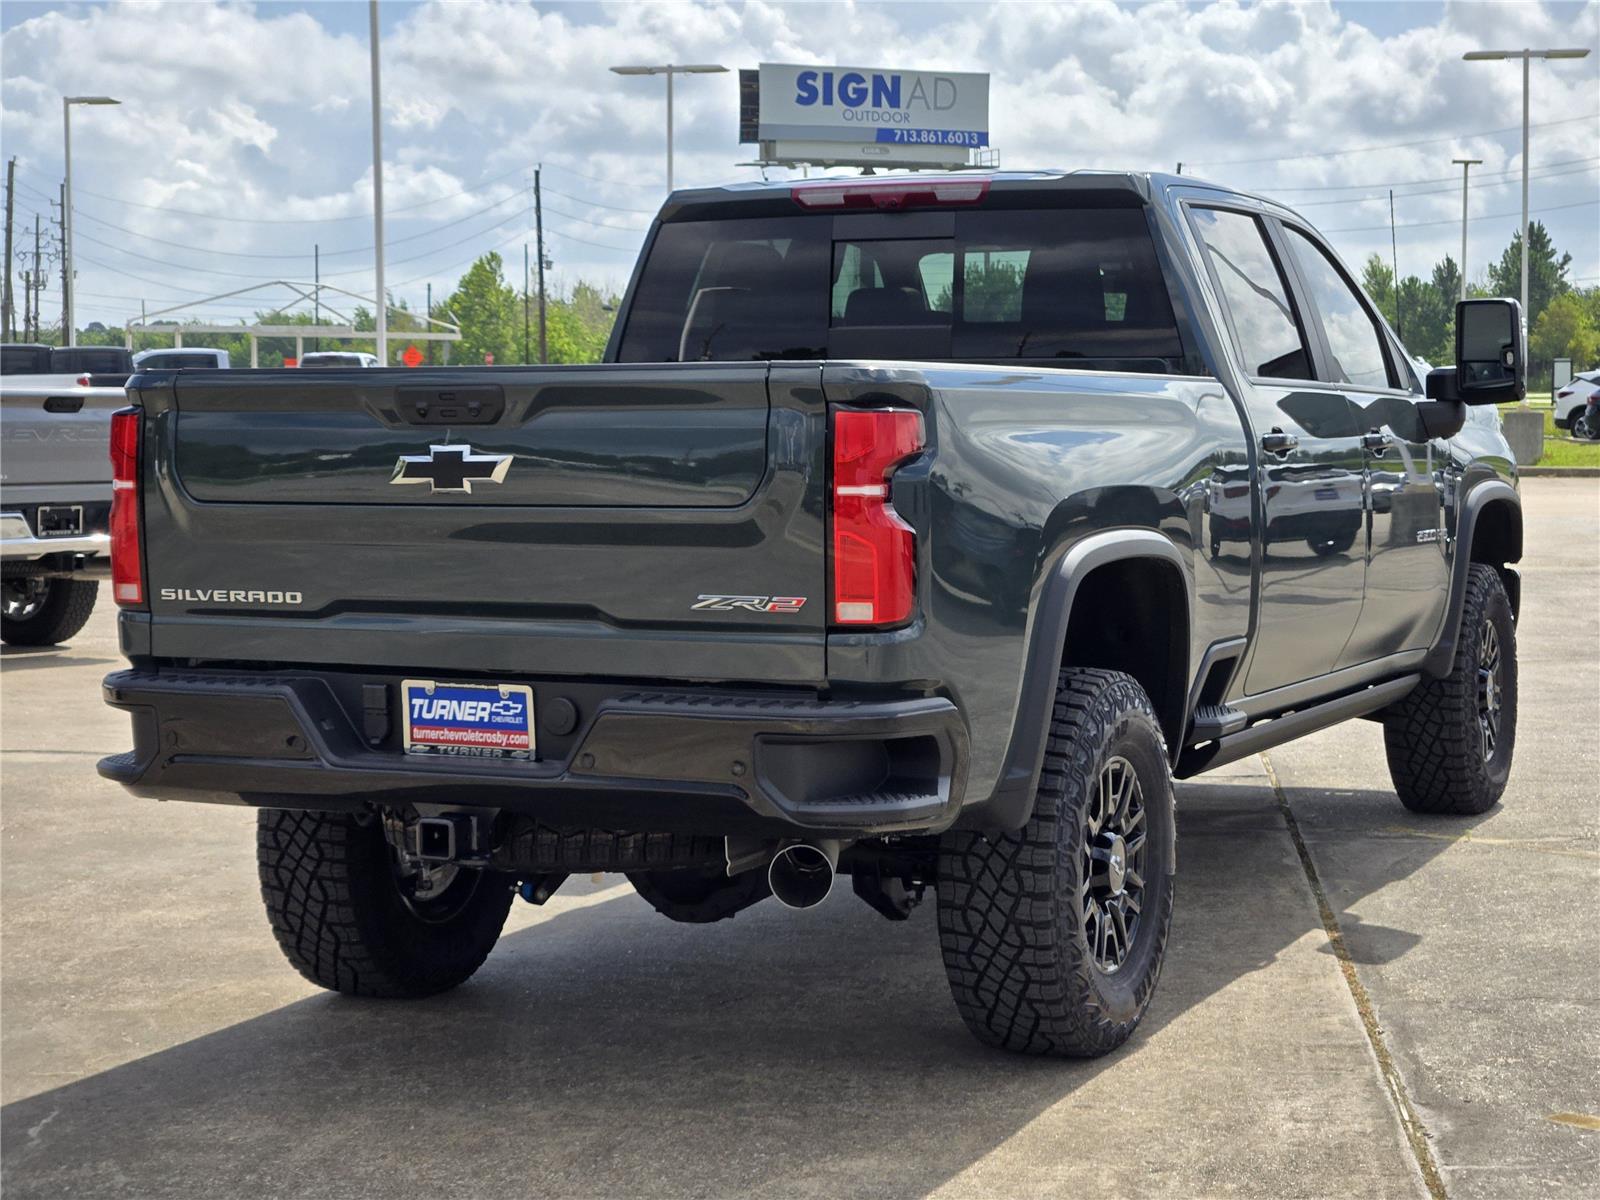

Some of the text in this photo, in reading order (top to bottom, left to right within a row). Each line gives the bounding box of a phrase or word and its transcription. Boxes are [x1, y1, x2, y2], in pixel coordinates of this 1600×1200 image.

[842, 109, 910, 124] OUTDOOR
[894, 129, 978, 145] 713.861.6013
[161, 588, 303, 604] SILVERADO
[690, 594, 807, 613] ZR2
[411, 698, 491, 722] TURNER
[413, 727, 529, 746] turnerchevroletcrosby.com
[437, 745, 503, 758] TURNER
